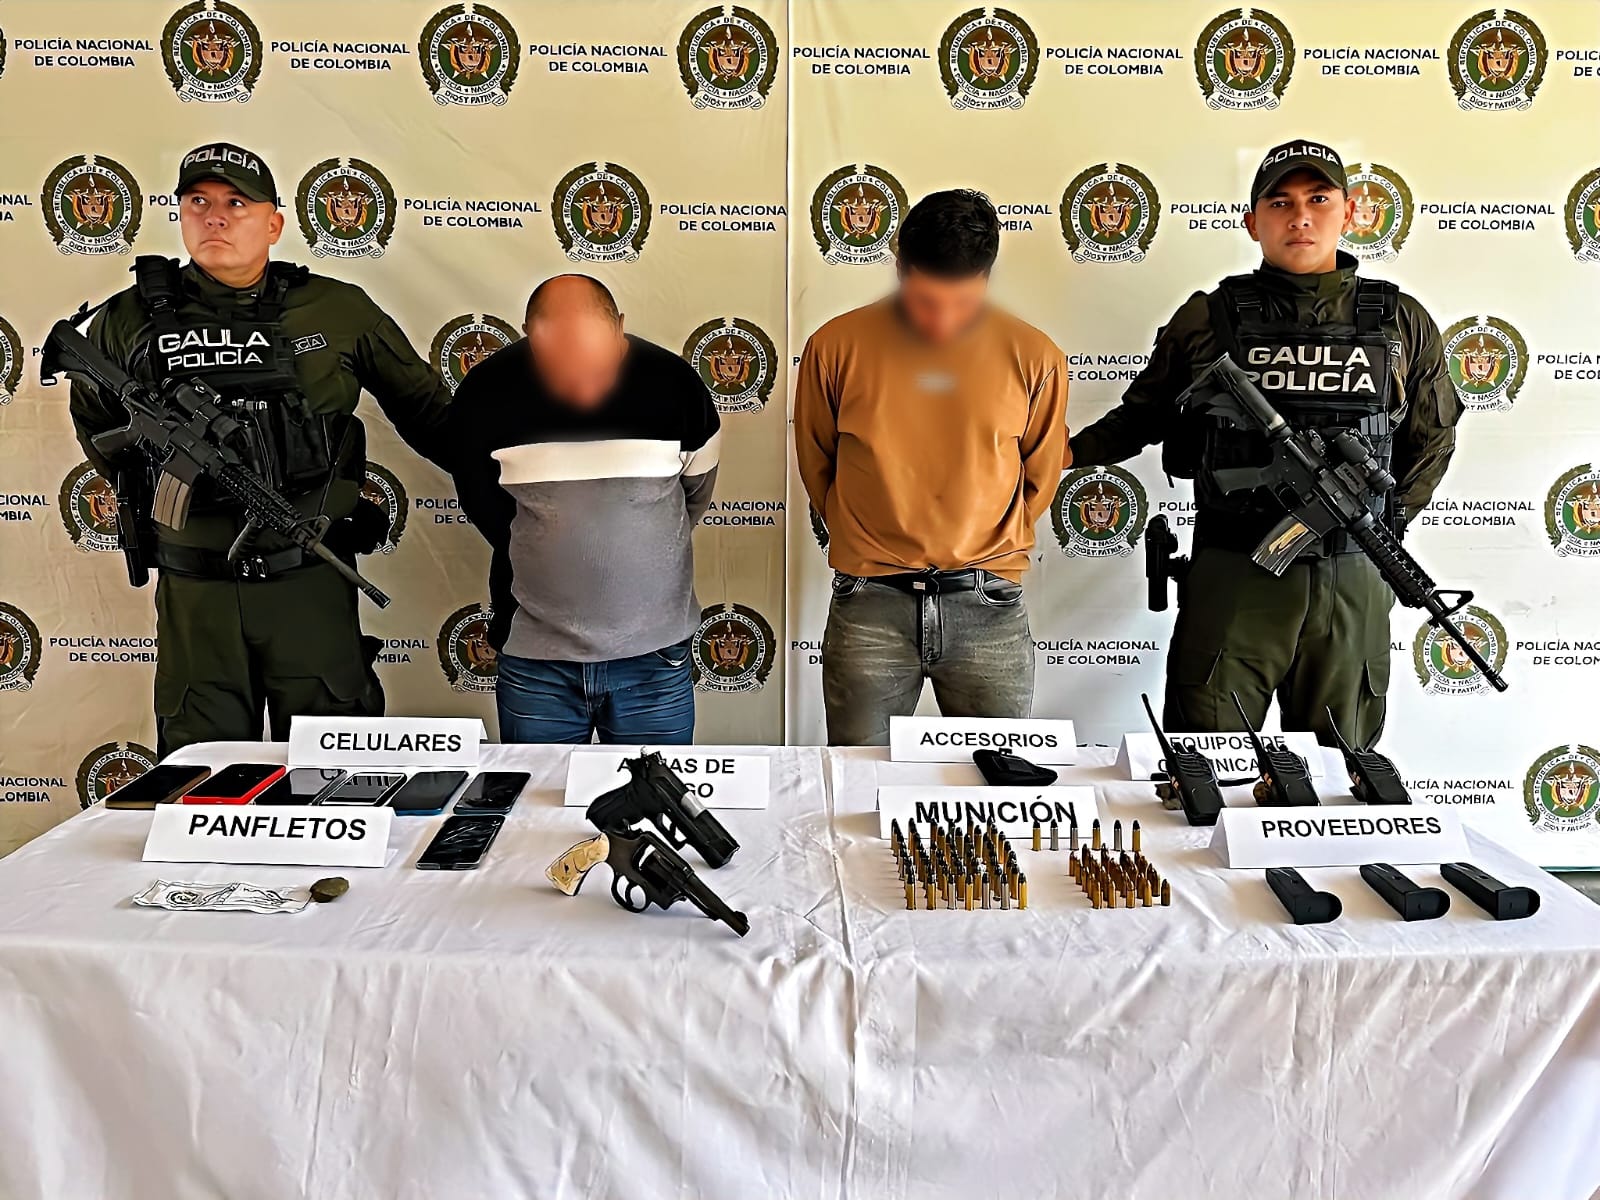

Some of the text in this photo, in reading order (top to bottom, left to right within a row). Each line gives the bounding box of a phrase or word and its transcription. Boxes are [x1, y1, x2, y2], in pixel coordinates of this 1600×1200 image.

[14, 36, 154, 51] POLICÍA NACIONAL
[271, 39, 411, 54] POLICÍA NACIONAL
[529, 42, 668, 57] POLICÍA NACIONAL
[793, 44, 931, 59] POLICÍA NACIONAL
[1046, 45, 1184, 59] POLICÍA NACIONAL
[1303, 46, 1441, 60] POLICÍA NACIONAL
[1555, 50, 1597, 61] POLIC
[34, 55, 135, 67] DE COLOMBIA
[290, 58, 392, 71] DE COLOMBIA
[548, 61, 649, 74] DE COLOMBIA
[811, 63, 911, 75] DE COLOMBIA
[1065, 64, 1164, 75] DE COLOMBIA
[1322, 65, 1421, 76] DE COLOMBIA
[1573, 66, 1593, 77] DE
[183, 147, 261, 175] POLICÍA
[1261, 145, 1338, 172] POLICÍA
[404, 196, 542, 213] POLICÍA NACIONAL
[660, 202, 786, 216] POLICÍA NACIONA
[998, 204, 1053, 215] CIONAL
[1170, 201, 1227, 215] POLICÍA
[1420, 201, 1555, 215] POLICÍA NACIONAL
[423, 215, 523, 228] DE COLOMBIA
[679, 220, 777, 232] DE COLOMBIA
[998, 220, 1033, 231] MBIA
[1189, 219, 1207, 230] DE
[1438, 219, 1535, 231] DE COLOMBIA
[158, 328, 271, 353] GAULA
[295, 336, 322, 350] ICÍA
[167, 348, 263, 371] POLICÍA
[1066, 353, 1151, 367] ICÍA NACION
[1247, 345, 1372, 368] GAULA
[1537, 352, 1592, 365] POLICÍA
[1078, 370, 1138, 381] COLOMB
[1554, 369, 1573, 380] DE
[0, 494, 51, 506] CIONAL
[415, 499, 462, 509] POLIC
[1423, 497, 1535, 511] LICÍA NACIONAL
[721, 501, 785, 512] NACIONA
[1158, 502, 1197, 512] POLIC
[0, 510, 33, 521] MBIA
[434, 514, 453, 524] DE
[703, 515, 776, 526] COLOMBIA
[1176, 516, 1195, 526] DE
[1421, 515, 1516, 526] DE COLOMBIA
[49, 635, 106, 648] POLICÍA
[383, 639, 430, 649] IONAL
[791, 641, 822, 652] POLI
[1087, 640, 1160, 651] NACIONAL
[1516, 638, 1570, 651] POLICÍA
[69, 652, 88, 662] DE
[377, 654, 411, 663] MBIA
[1046, 655, 1141, 665] DE COLOMBIA
[1532, 655, 1600, 666] DE COLOM
[319, 732, 462, 752] CELULARES
[919, 731, 1058, 748] ACCESORIOS
[617, 757, 735, 774] AAS DE
[0, 776, 68, 788] NACIONAL
[1405, 778, 1514, 790] LICÍA NACIONAL
[0, 791, 51, 803] LOMBIA
[915, 794, 1077, 824] MUNICIÓN
[188, 813, 367, 841] PANFLETOS
[1261, 816, 1442, 838] PROVEEDORES
